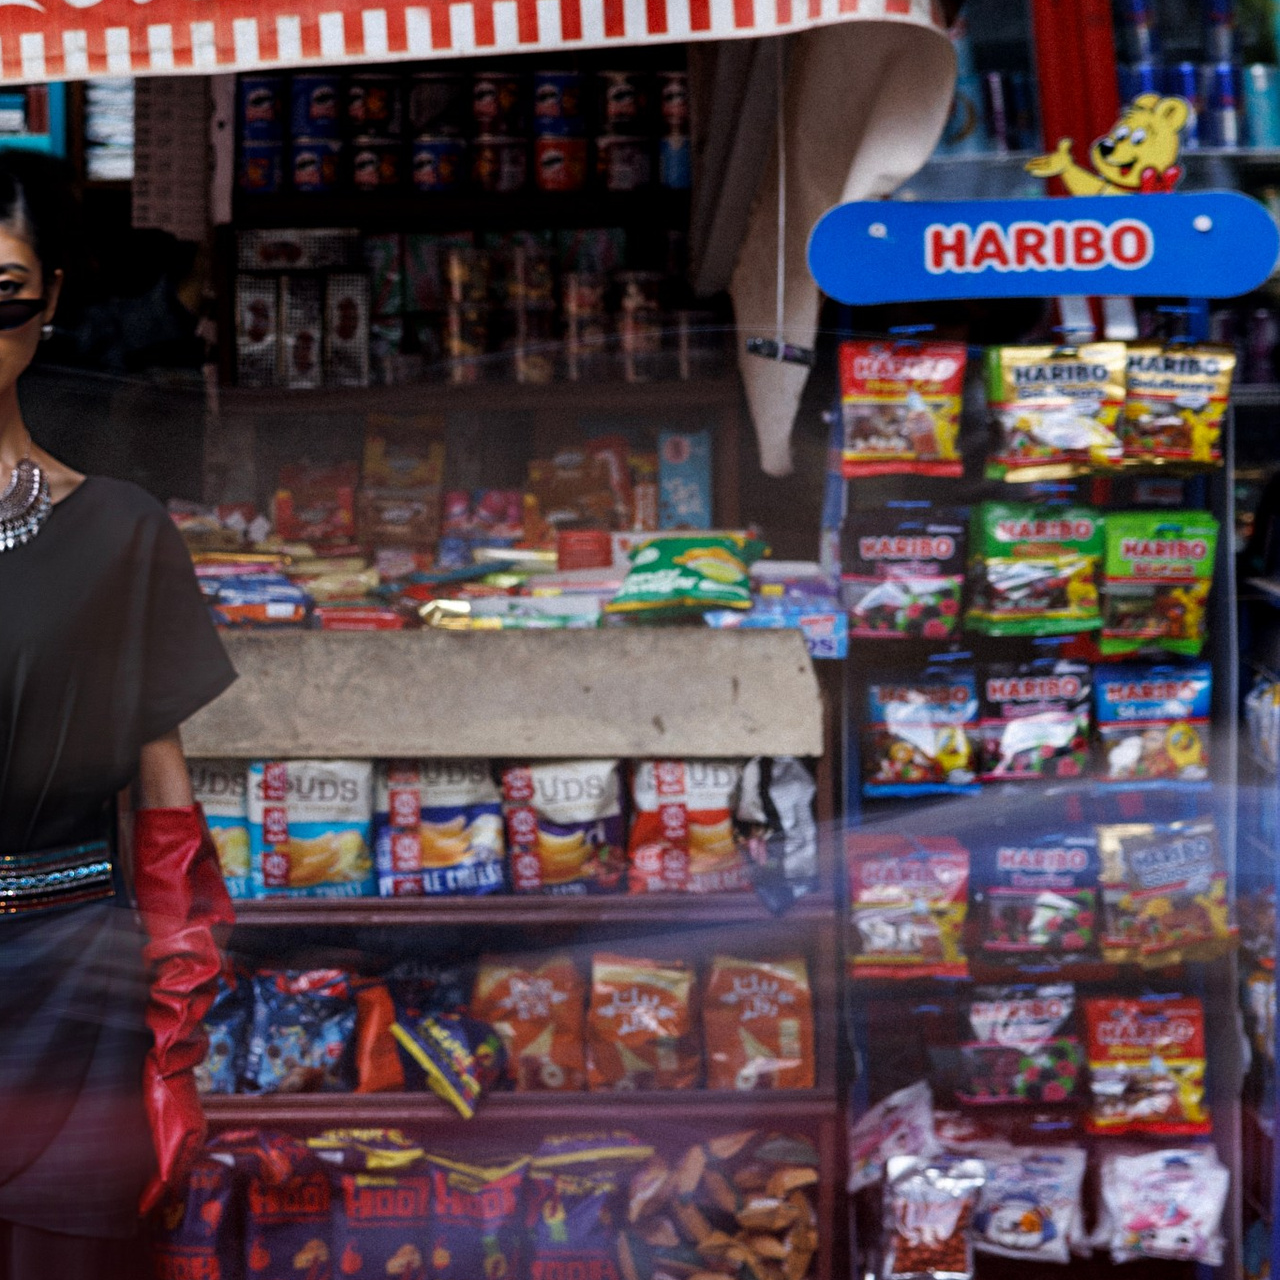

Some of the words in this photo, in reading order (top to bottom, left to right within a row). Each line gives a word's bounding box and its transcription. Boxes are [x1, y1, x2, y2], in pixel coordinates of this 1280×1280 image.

[925, 219, 1154, 274] HARIBO
[853, 355, 958, 381] HARO
[1013, 363, 1109, 383] HARIBO
[1125, 354, 1221, 376] HARIBO
[994, 519, 1094, 542] HARIBO
[859, 536, 956, 561] HARIBO
[1121, 537, 1208, 562] HARIBO
[986, 675, 1083, 702] HARIBO
[995, 846, 1090, 873] HARIBO
